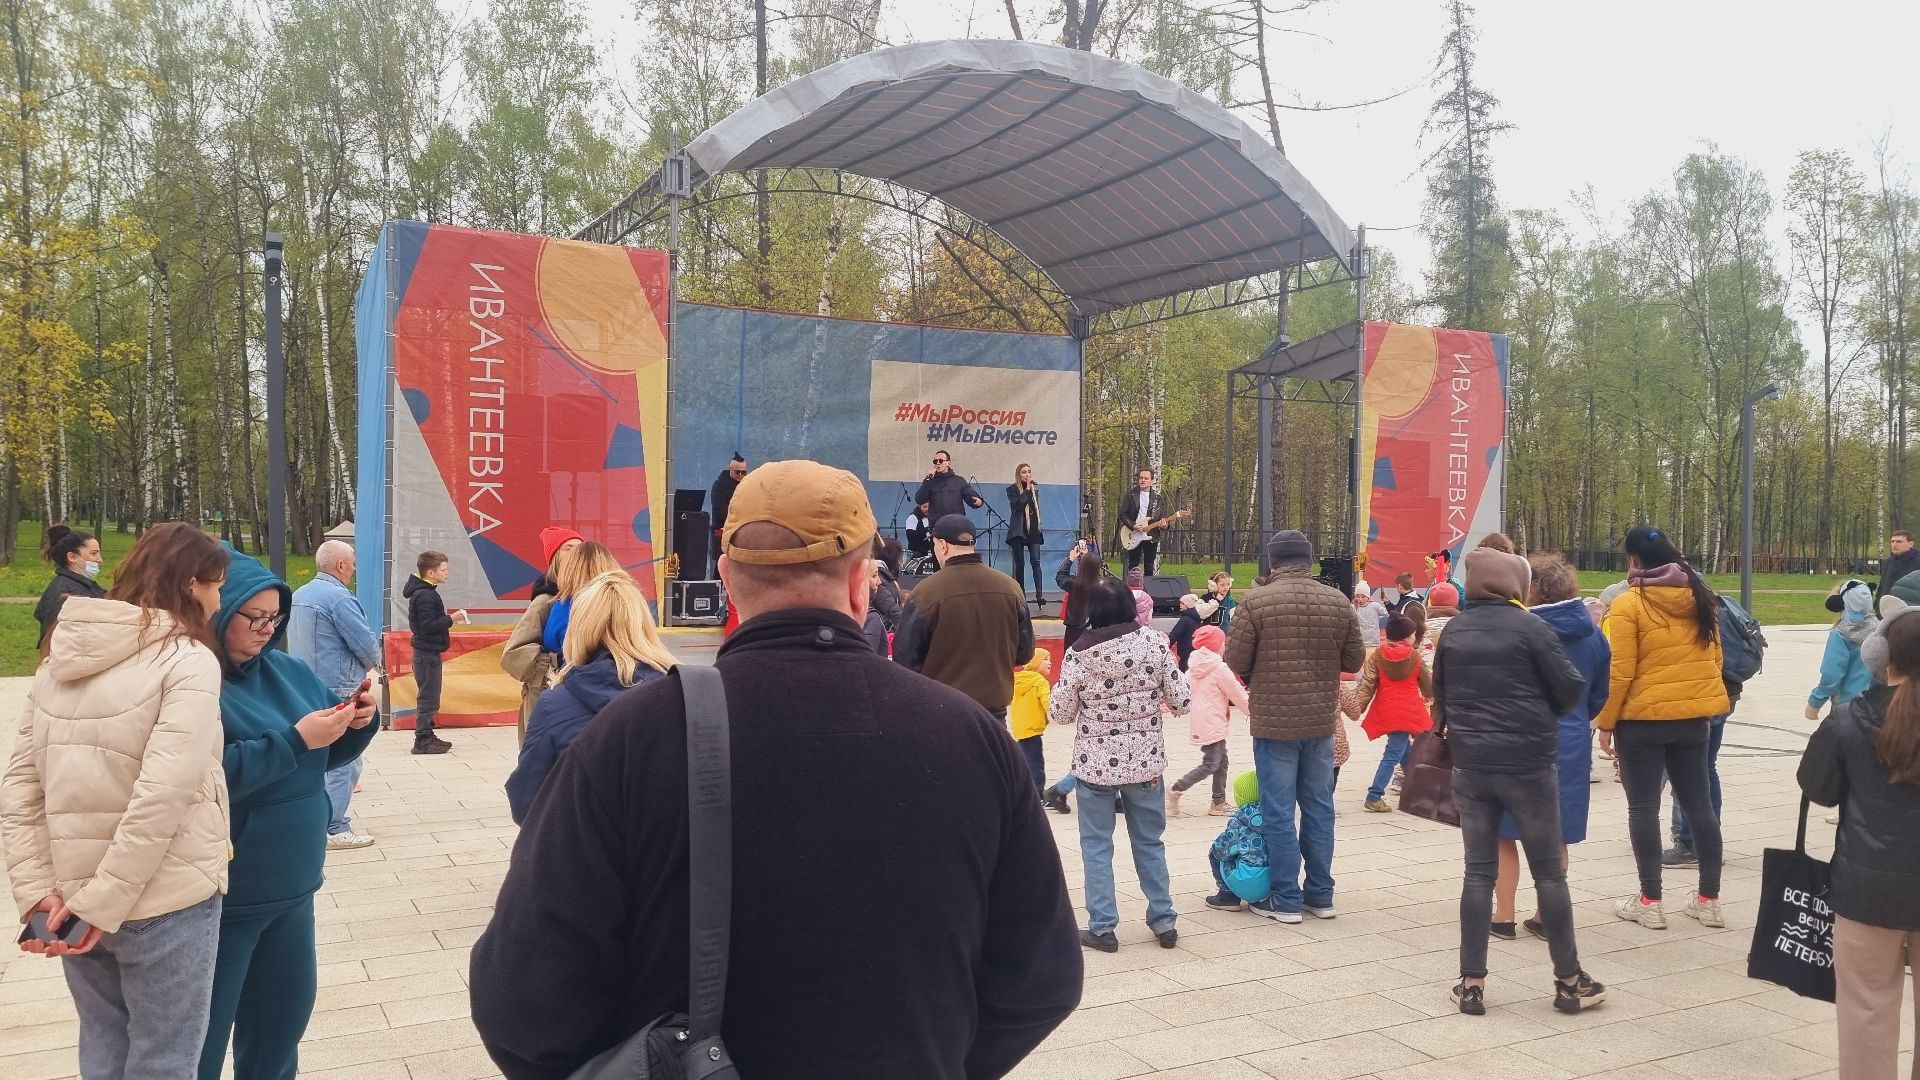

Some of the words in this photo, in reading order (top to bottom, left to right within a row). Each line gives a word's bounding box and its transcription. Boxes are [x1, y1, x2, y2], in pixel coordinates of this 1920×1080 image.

[468, 262, 505, 538] ИВАНТЕЕВКА
[894, 402, 1027, 426] #МыРоссия
[926, 423, 1058, 446] #МыВместе
[1447, 352, 1472, 545] ИВАНТЕЕВКА
[1783, 887, 1811, 908] ВСЕ
